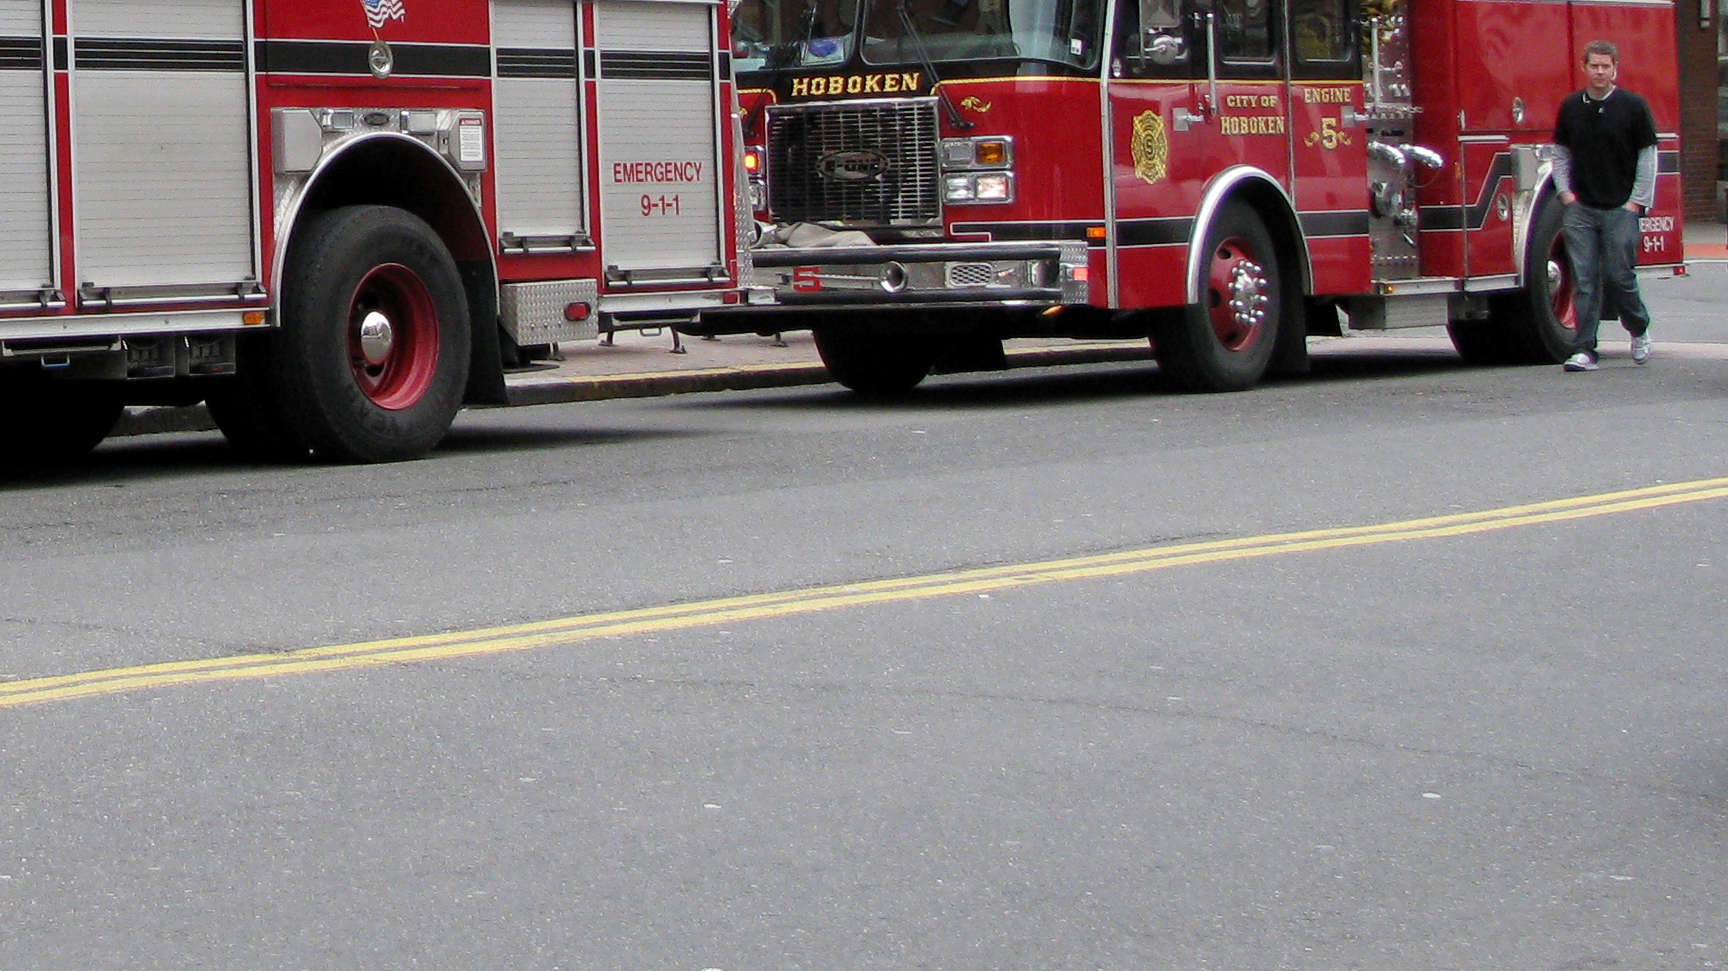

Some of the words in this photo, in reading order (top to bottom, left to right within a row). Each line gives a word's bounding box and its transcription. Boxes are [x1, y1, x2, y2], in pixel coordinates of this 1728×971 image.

[791, 72, 921, 97] HOBOKEN
[1304, 87, 1352, 104] ENGINE
[1226, 95, 1258, 108] CITY
[1260, 95, 1278, 108] OF
[1220, 116, 1285, 136] HOBOKEN
[1321, 117, 1338, 149] 5
[613, 161, 703, 183] EMERGENCY
[641, 194, 680, 217] 9-1-1
[1638, 216, 1675, 233] ERGENCY
[793, 266, 822, 293] 5
